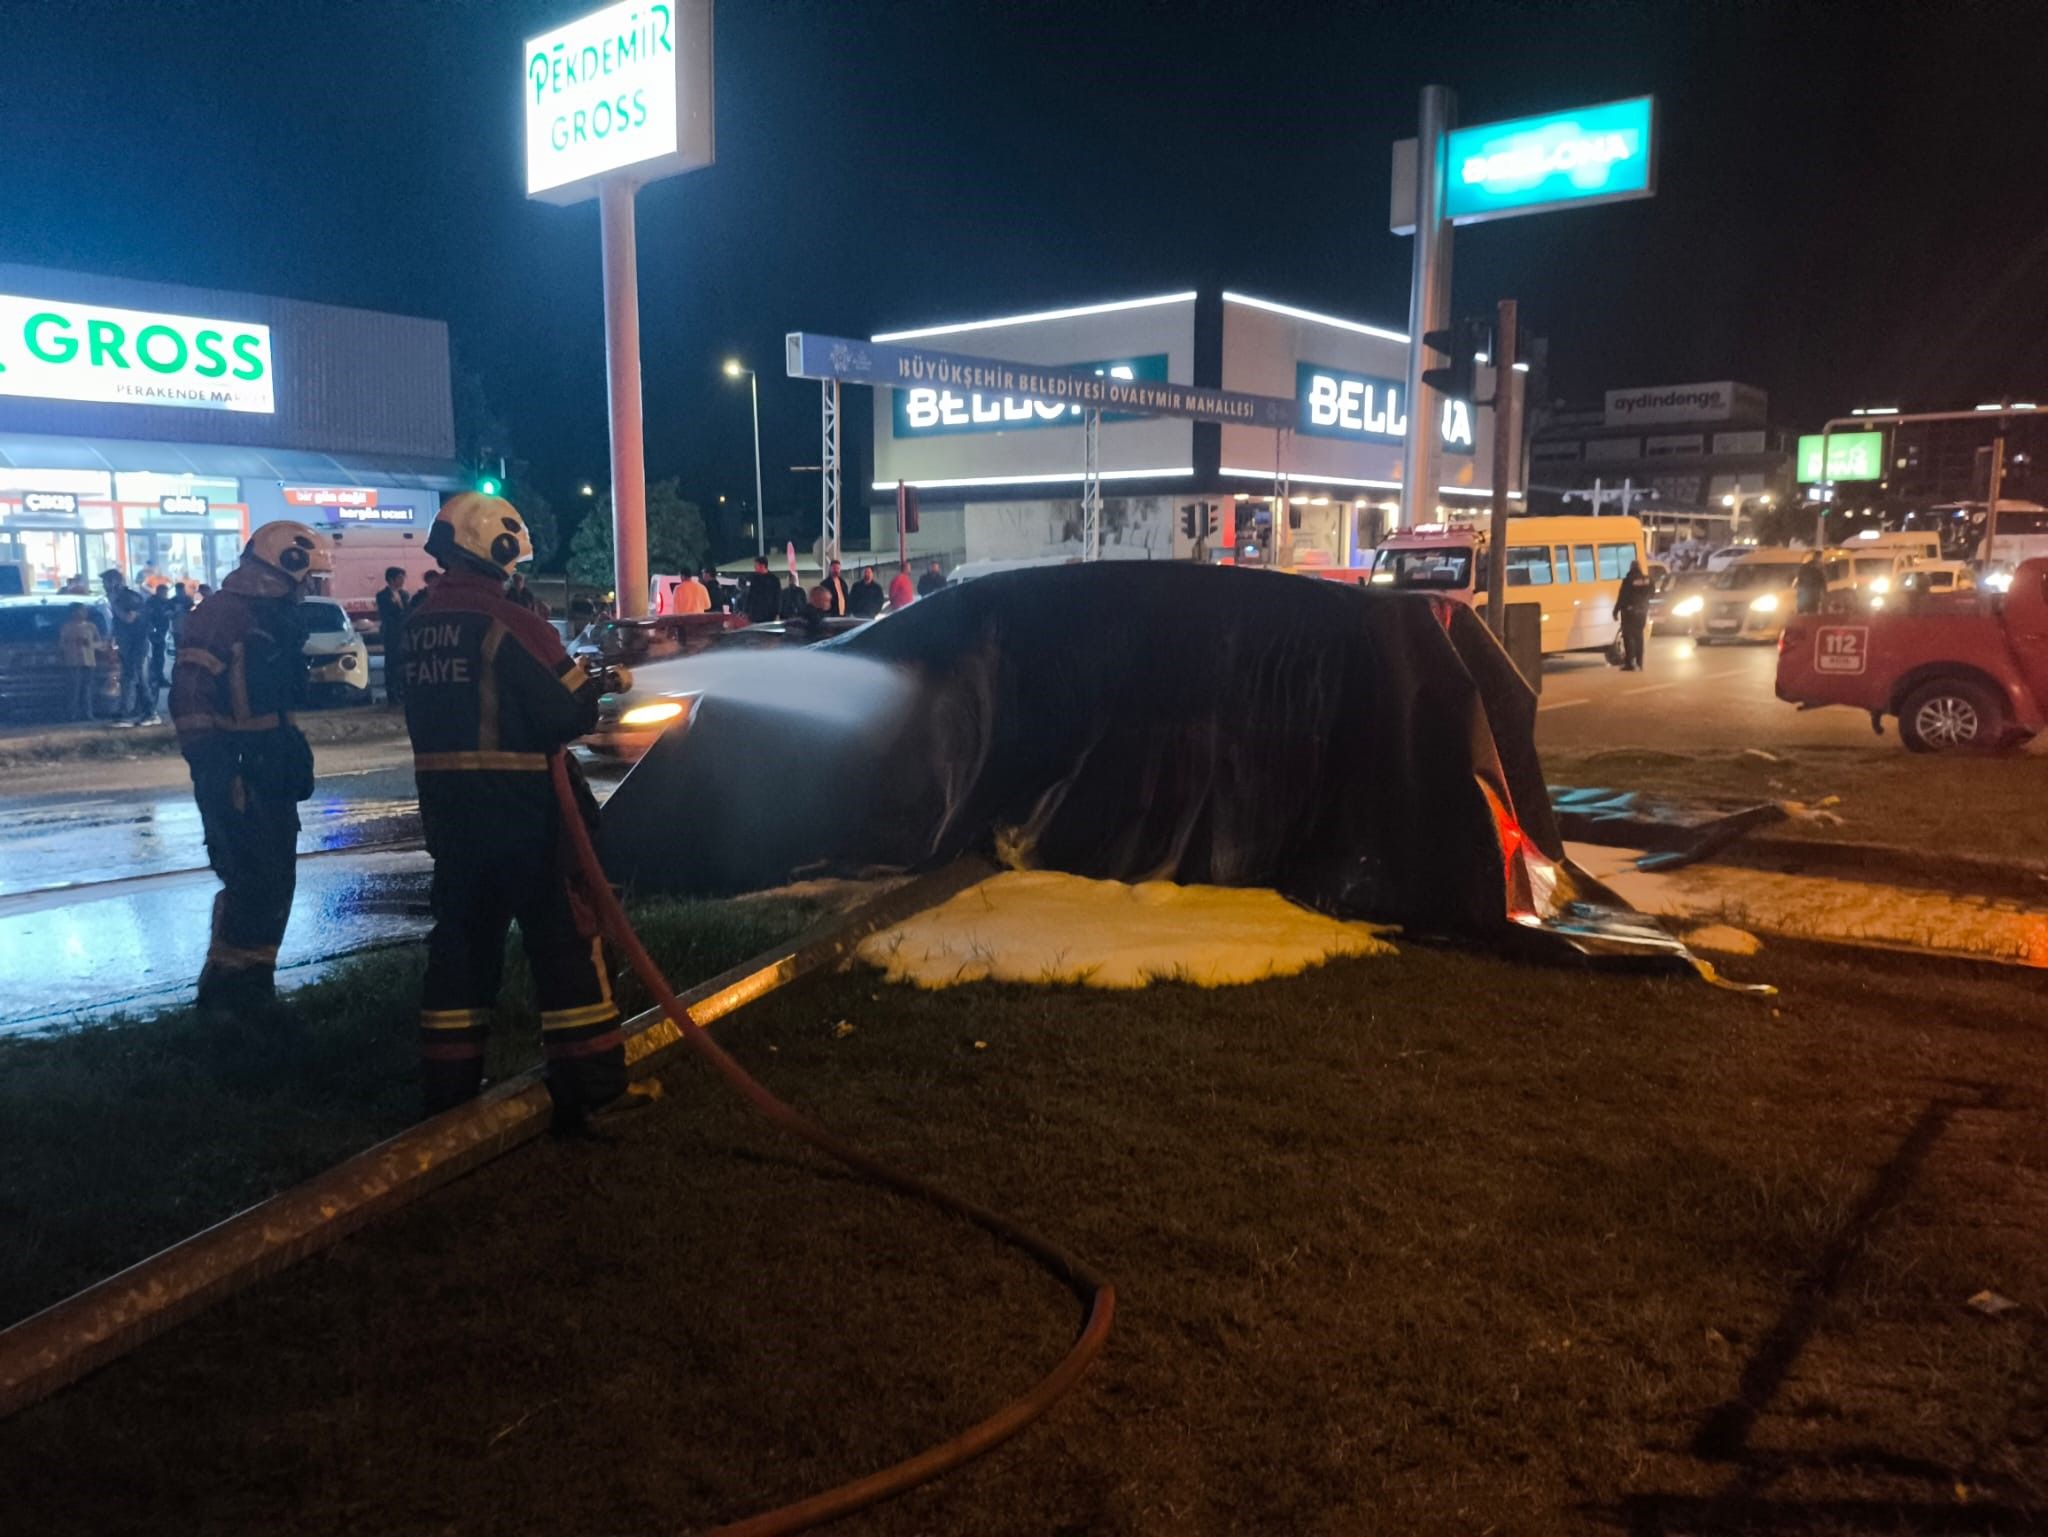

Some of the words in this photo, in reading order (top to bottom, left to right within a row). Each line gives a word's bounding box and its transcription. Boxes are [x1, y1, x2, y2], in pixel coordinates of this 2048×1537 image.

[551, 89, 648, 151] GROSS
[23, 312, 265, 381] GROSS
[116, 384, 206, 401] PERAKENDE
[899, 355, 1013, 389] BÜYÜKŞEHİR
[1019, 373, 1105, 399] BELEDİYESİ
[1110, 385, 1181, 408] OVAEYMİR
[1186, 396, 1254, 417] MAHALLESİ
[1309, 375, 1472, 445] BELLA
[402, 624, 461, 650] AYDIN
[1826, 634, 1857, 653] 112
[403, 653, 471, 685] FAİYE
